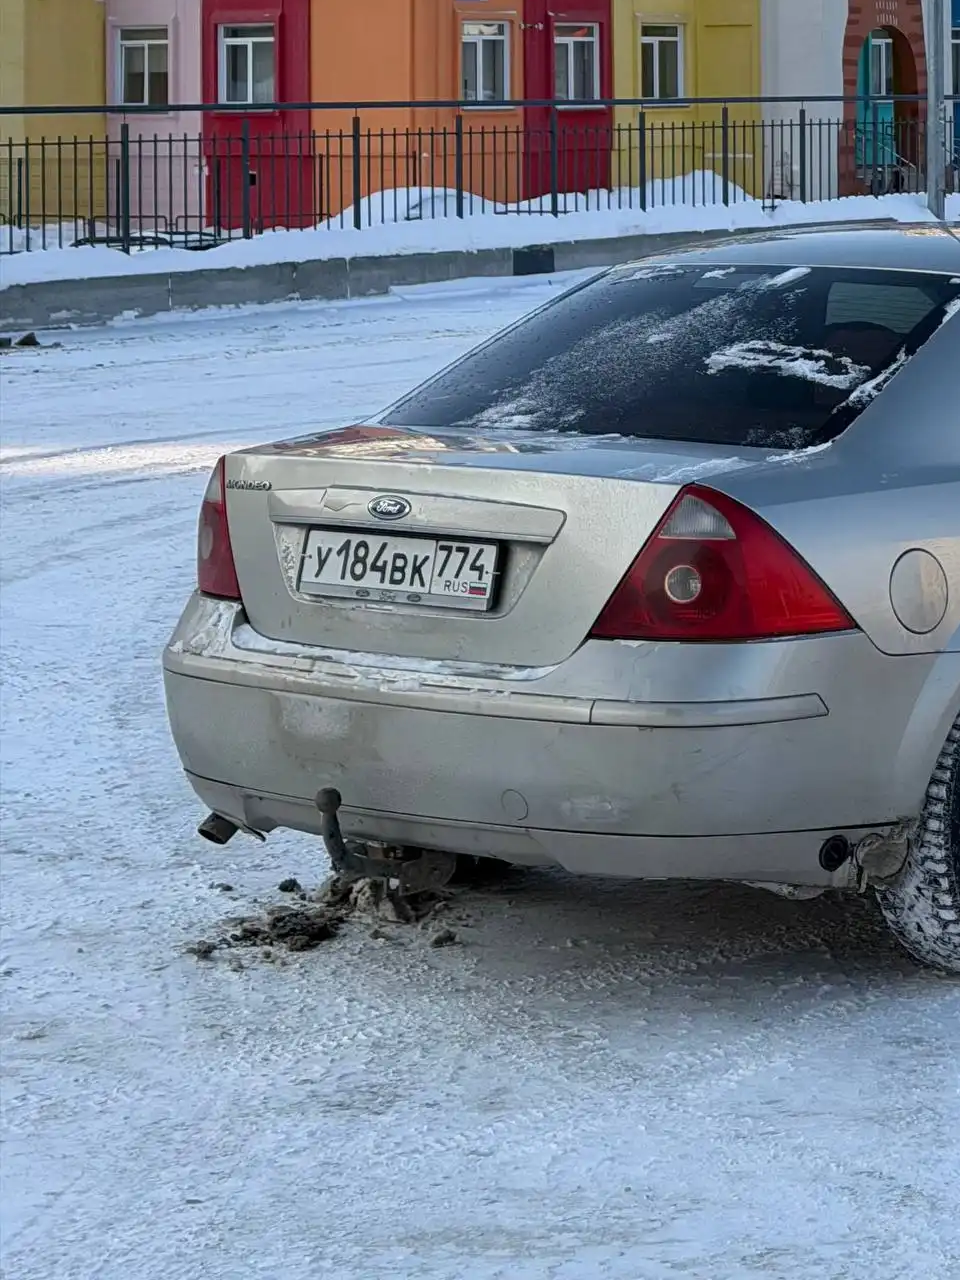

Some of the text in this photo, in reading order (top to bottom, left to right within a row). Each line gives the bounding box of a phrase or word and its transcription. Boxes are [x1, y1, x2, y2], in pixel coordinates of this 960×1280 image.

[376, 500, 401, 513] Ford
[315, 539, 485, 588] У184ВК 774
[443, 579, 468, 593] RUS
